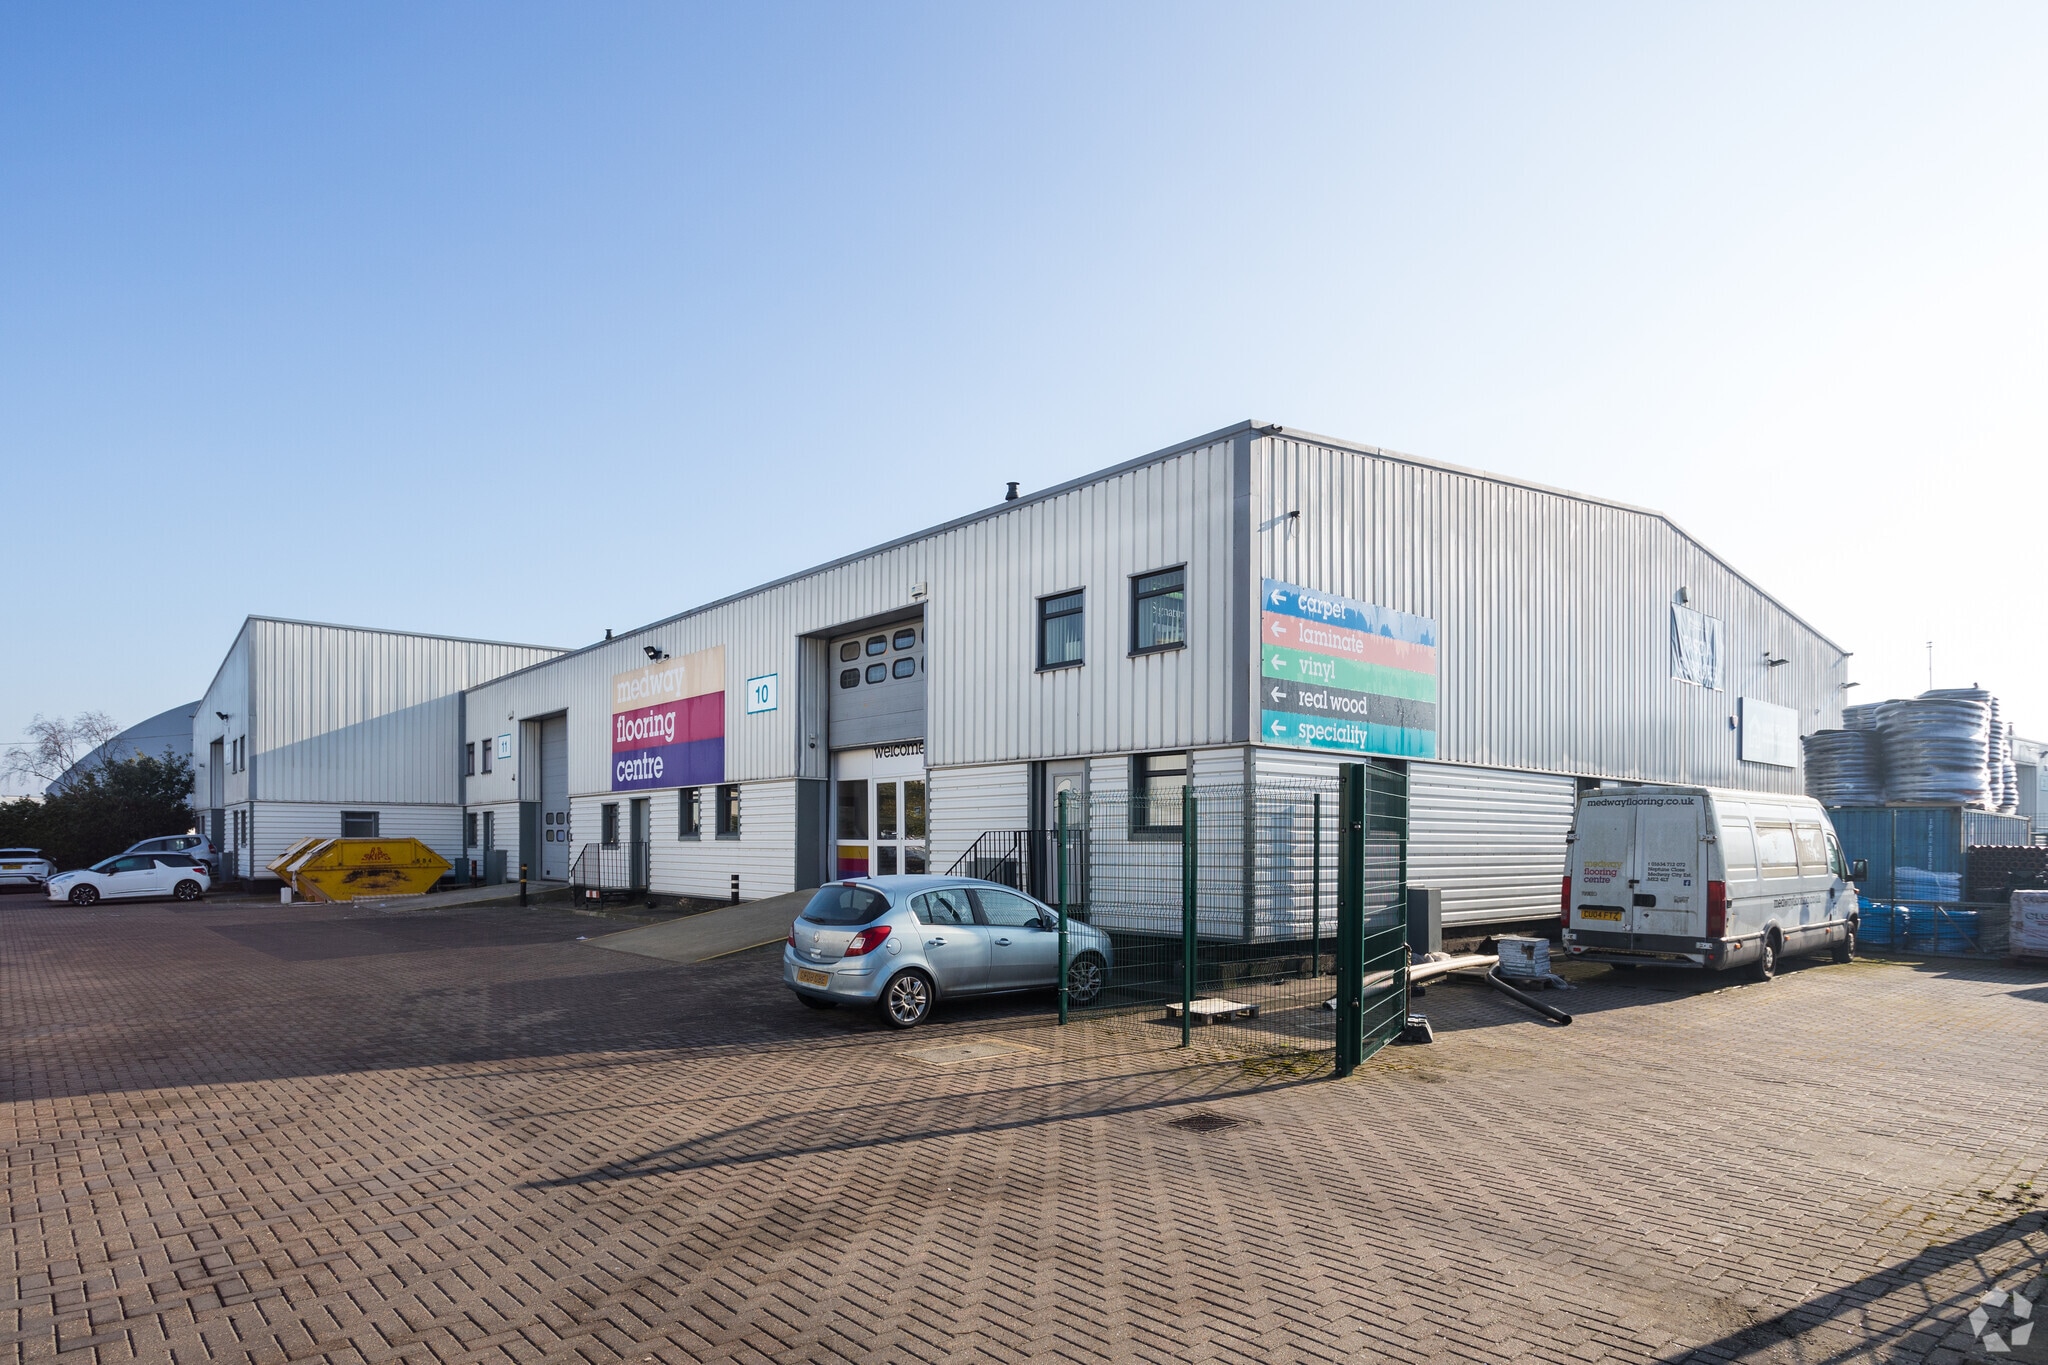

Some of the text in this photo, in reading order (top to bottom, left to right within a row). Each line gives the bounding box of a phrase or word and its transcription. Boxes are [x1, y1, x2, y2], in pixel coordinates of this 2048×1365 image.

[1298, 595, 1346, 620] carpet
[1299, 623, 1364, 654] laminate
[1299, 657, 1336, 683] vinyl
[617, 666, 685, 704] medway
[755, 684, 769, 704] 10
[1299, 690, 1367, 715] real wood
[616, 710, 676, 743] flooring
[1298, 722, 1368, 749] speciality
[501, 740, 508, 753] 11
[873, 742, 925, 759] welcome
[616, 752, 664, 782] centre
[1587, 797, 1695, 808] medwayflooring.co.uk
[1583, 860, 1623, 869] medway
[1583, 867, 1618, 877] flooring
[1583, 876, 1611, 884] centre
